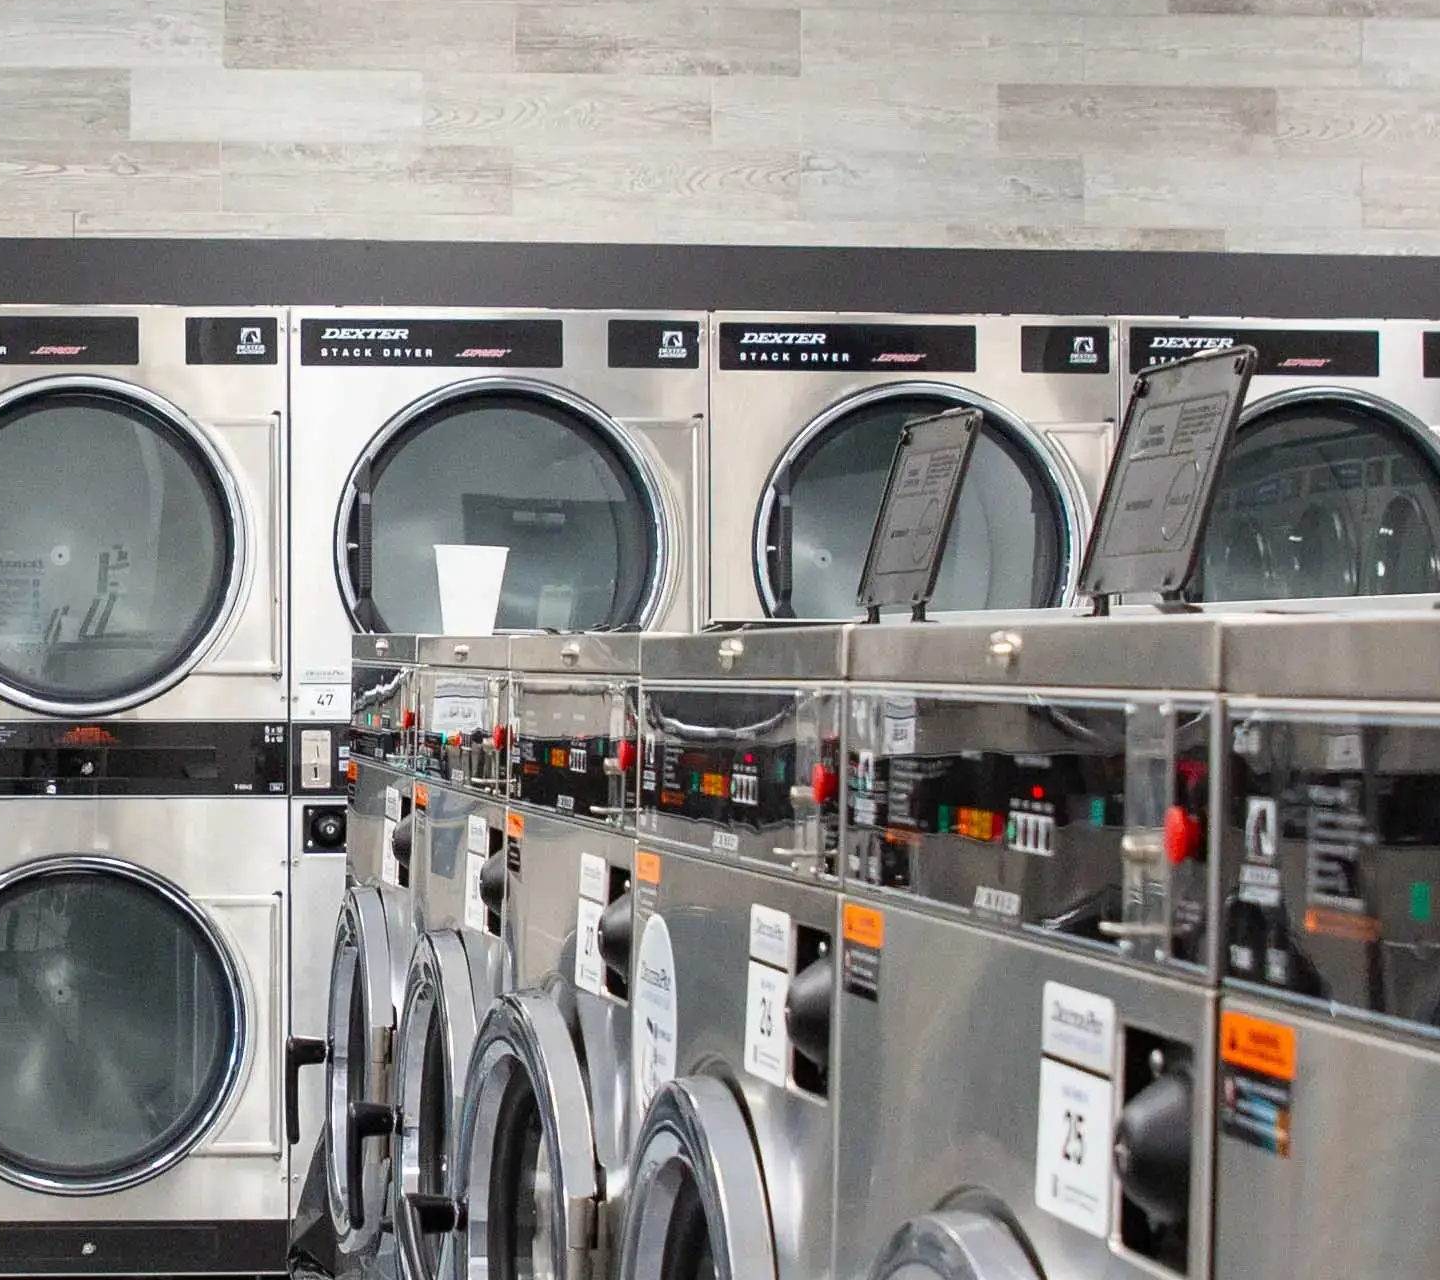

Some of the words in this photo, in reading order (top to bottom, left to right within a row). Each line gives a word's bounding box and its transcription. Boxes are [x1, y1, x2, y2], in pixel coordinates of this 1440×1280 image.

[321, 329, 409, 340] DEXTER
[740, 333, 826, 344] DEXTER
[1149, 337, 1234, 349] DEXTER
[321, 348, 372, 357] STACK
[383, 348, 433, 357] DRYER
[740, 352, 791, 362] STACK
[801, 352, 850, 362] DRYER
[317, 694, 334, 706] 47
